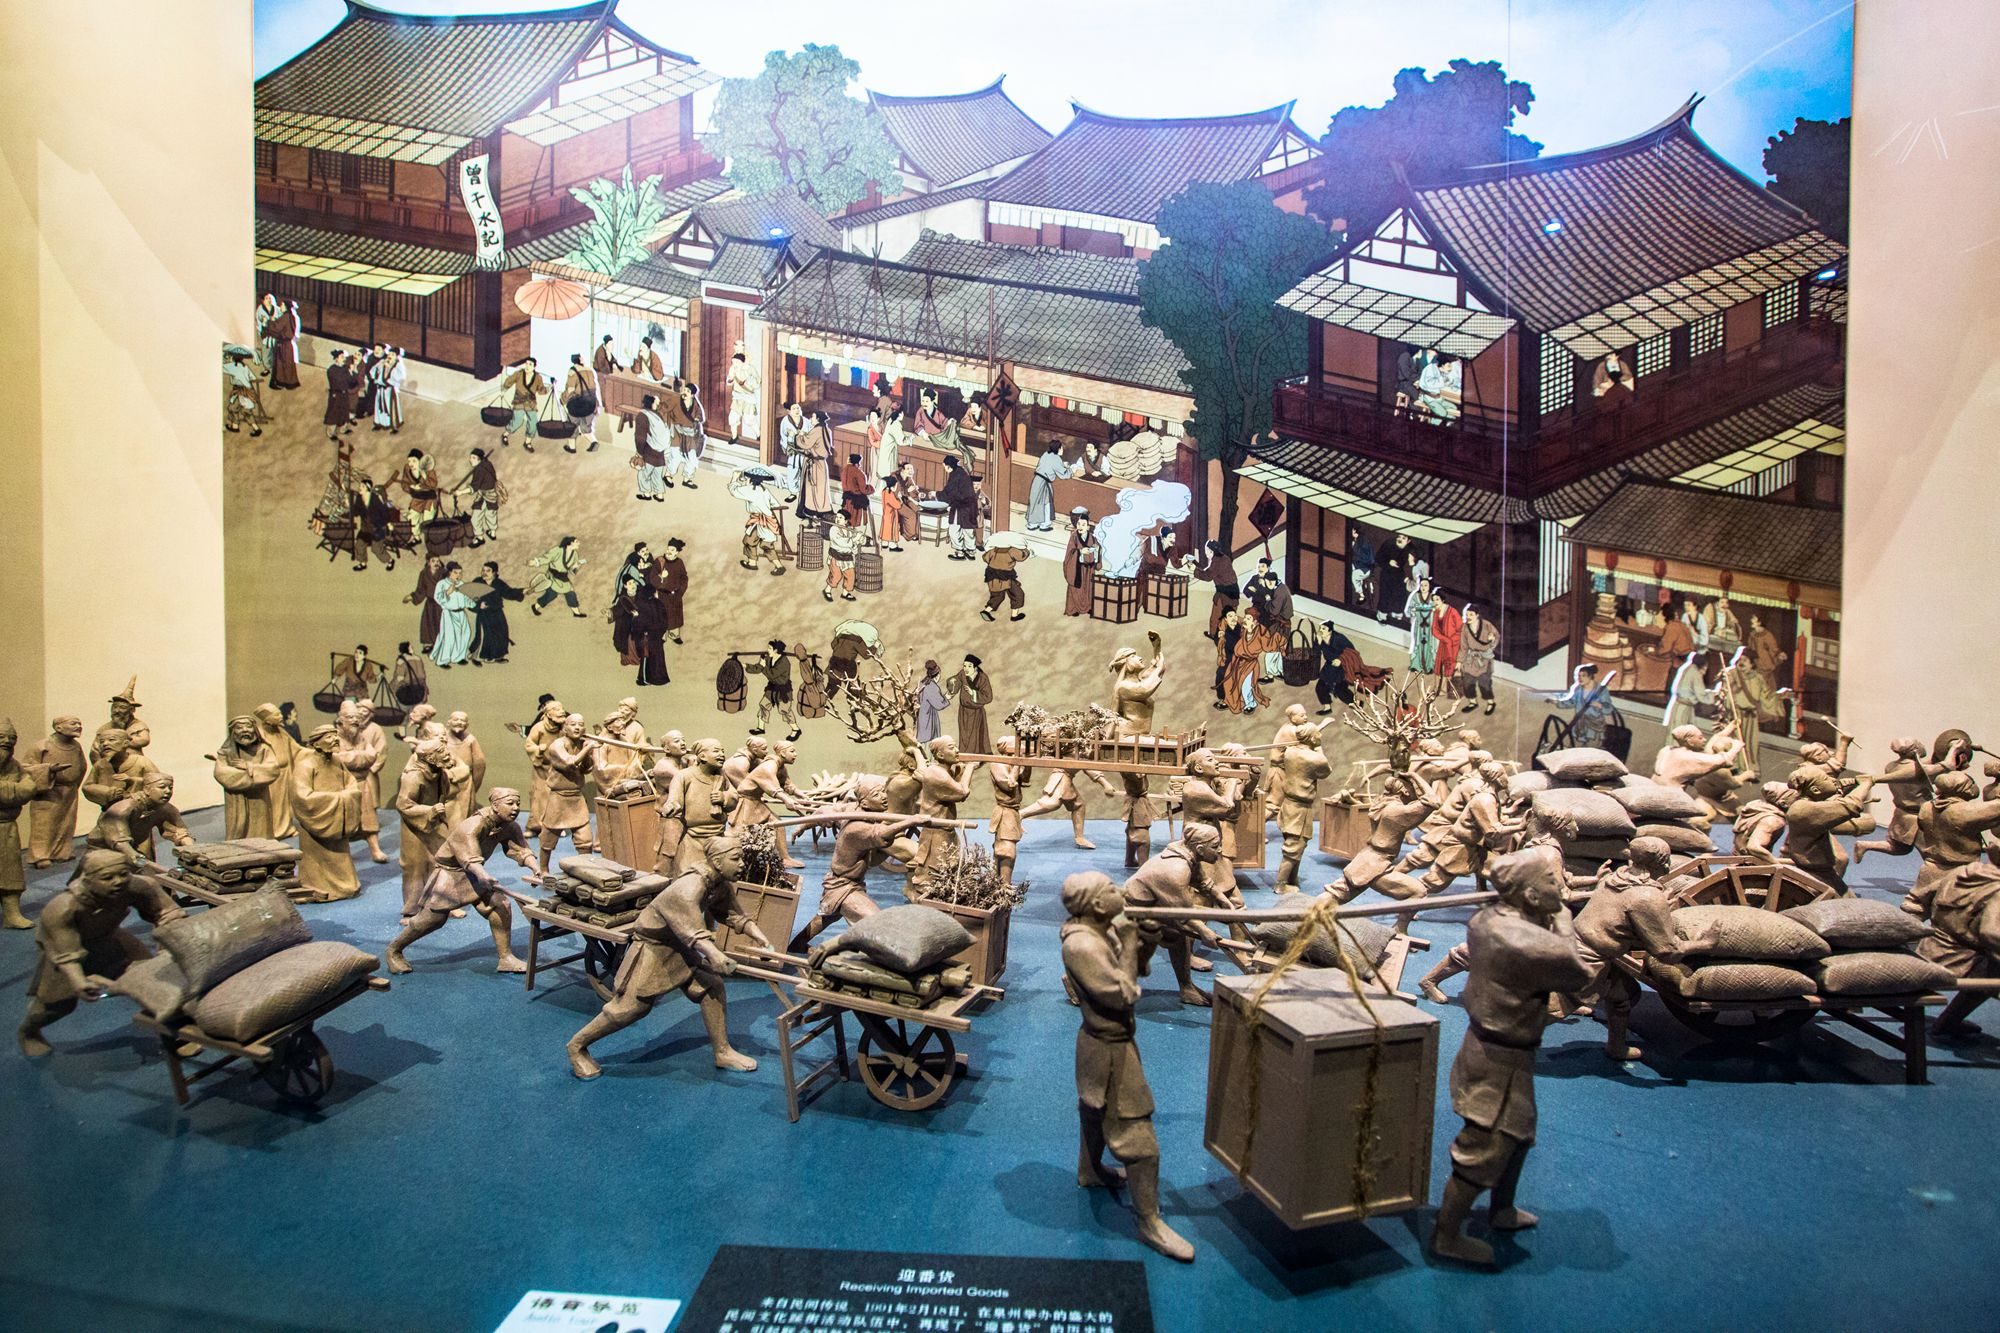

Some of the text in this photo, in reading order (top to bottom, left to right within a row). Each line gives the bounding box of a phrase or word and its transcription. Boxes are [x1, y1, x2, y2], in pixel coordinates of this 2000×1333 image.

[897, 1268, 955, 1284] 迎番货
[840, 1280, 1010, 1298] Receiving Imported Goods
